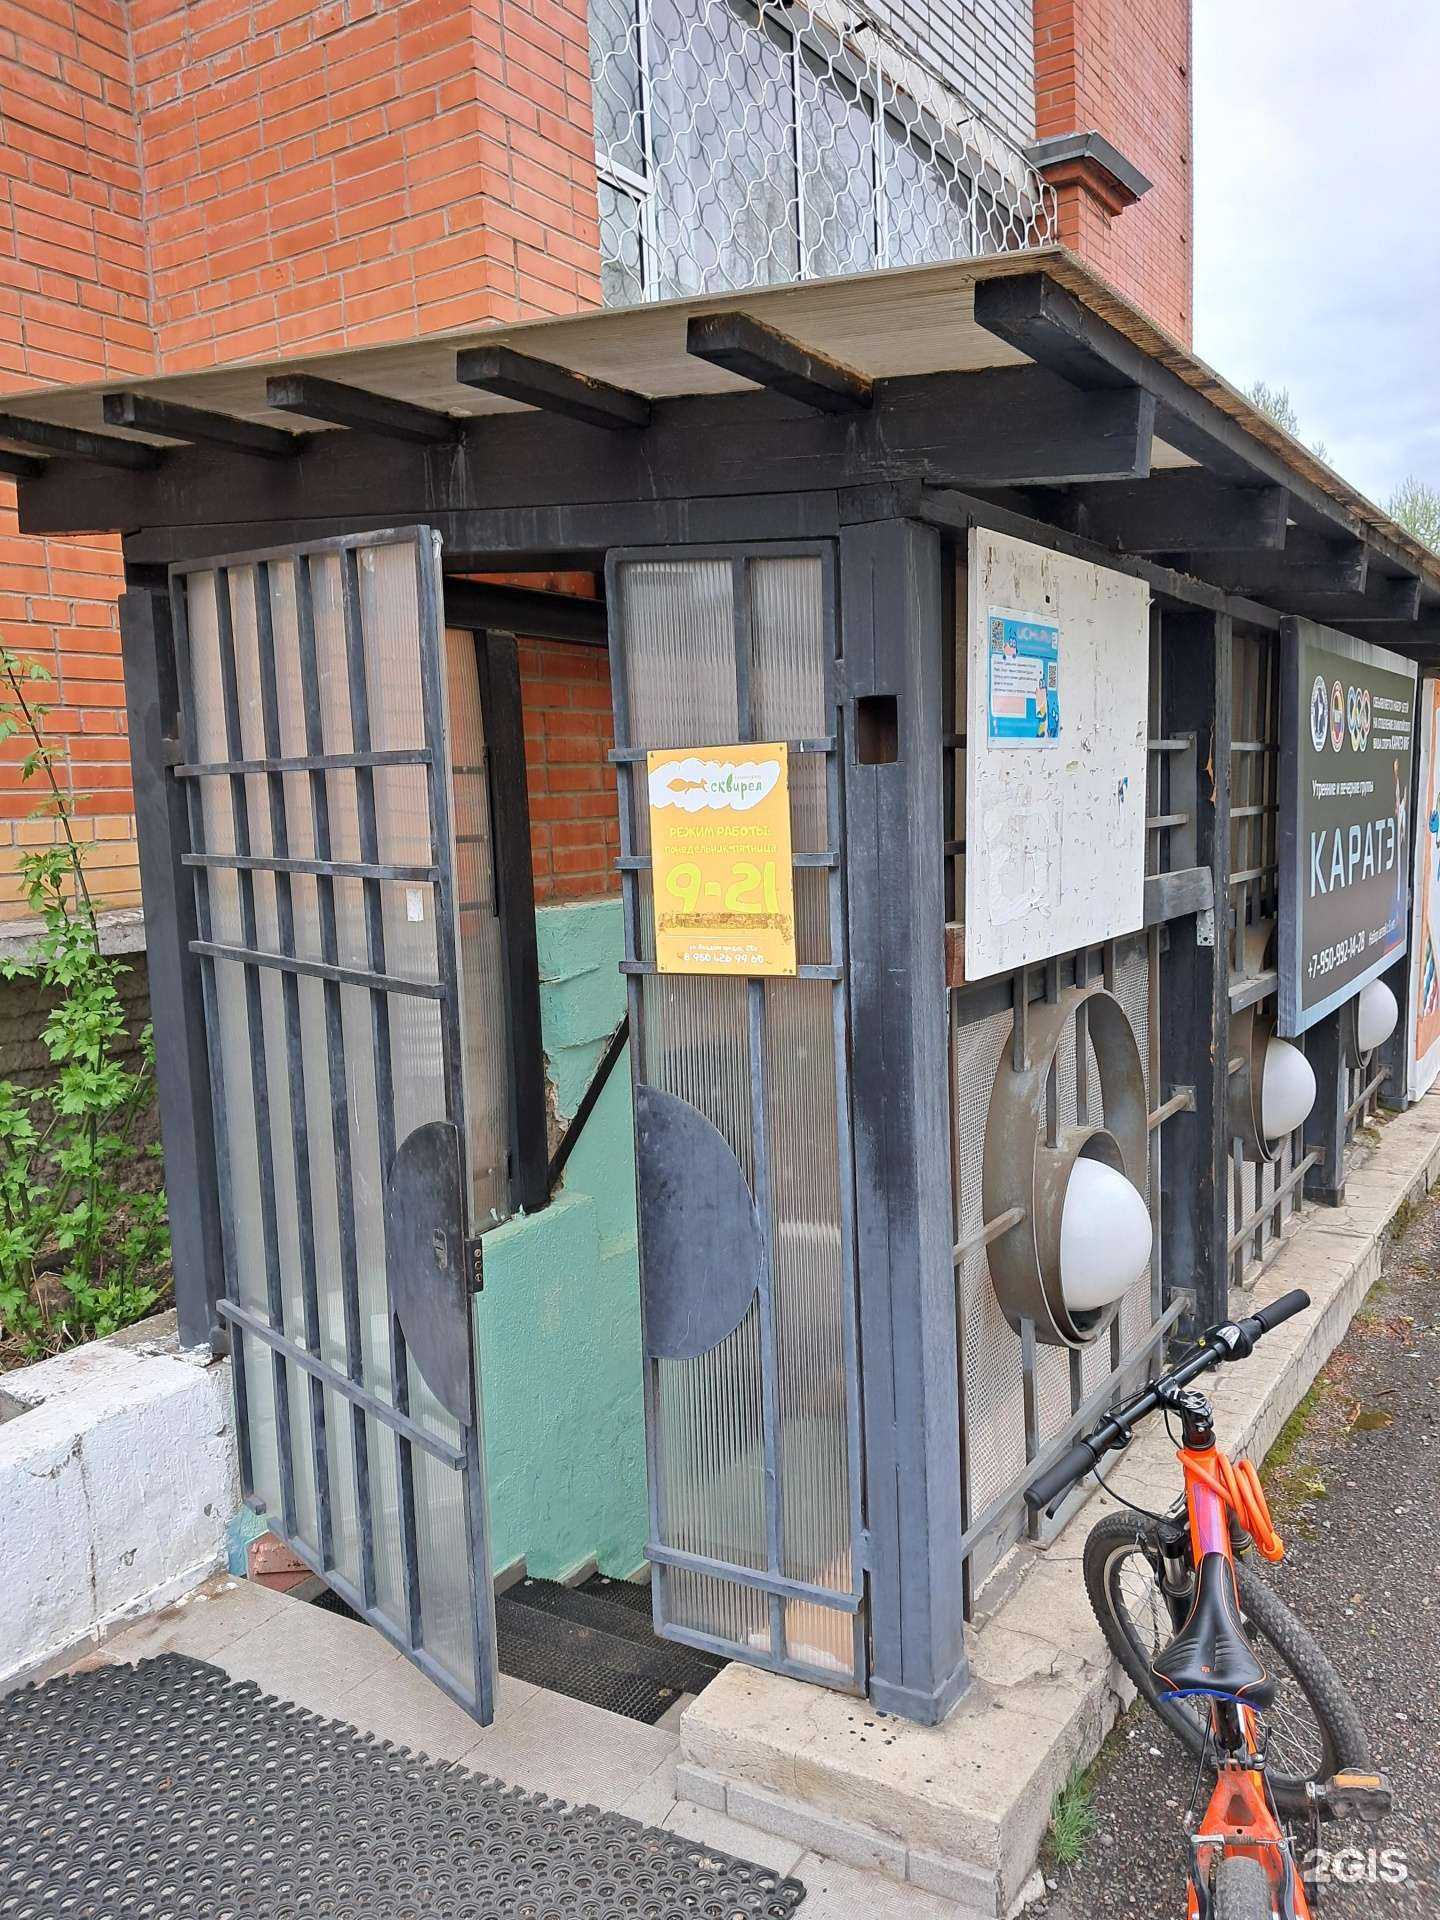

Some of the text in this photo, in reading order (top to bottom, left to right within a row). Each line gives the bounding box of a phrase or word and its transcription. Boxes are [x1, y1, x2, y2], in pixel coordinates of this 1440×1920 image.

[670, 826, 714, 838] РЕЖИМ
[1310, 817, 1395, 898] КАРАТЭ
[665, 861, 780, 915] 9-21
